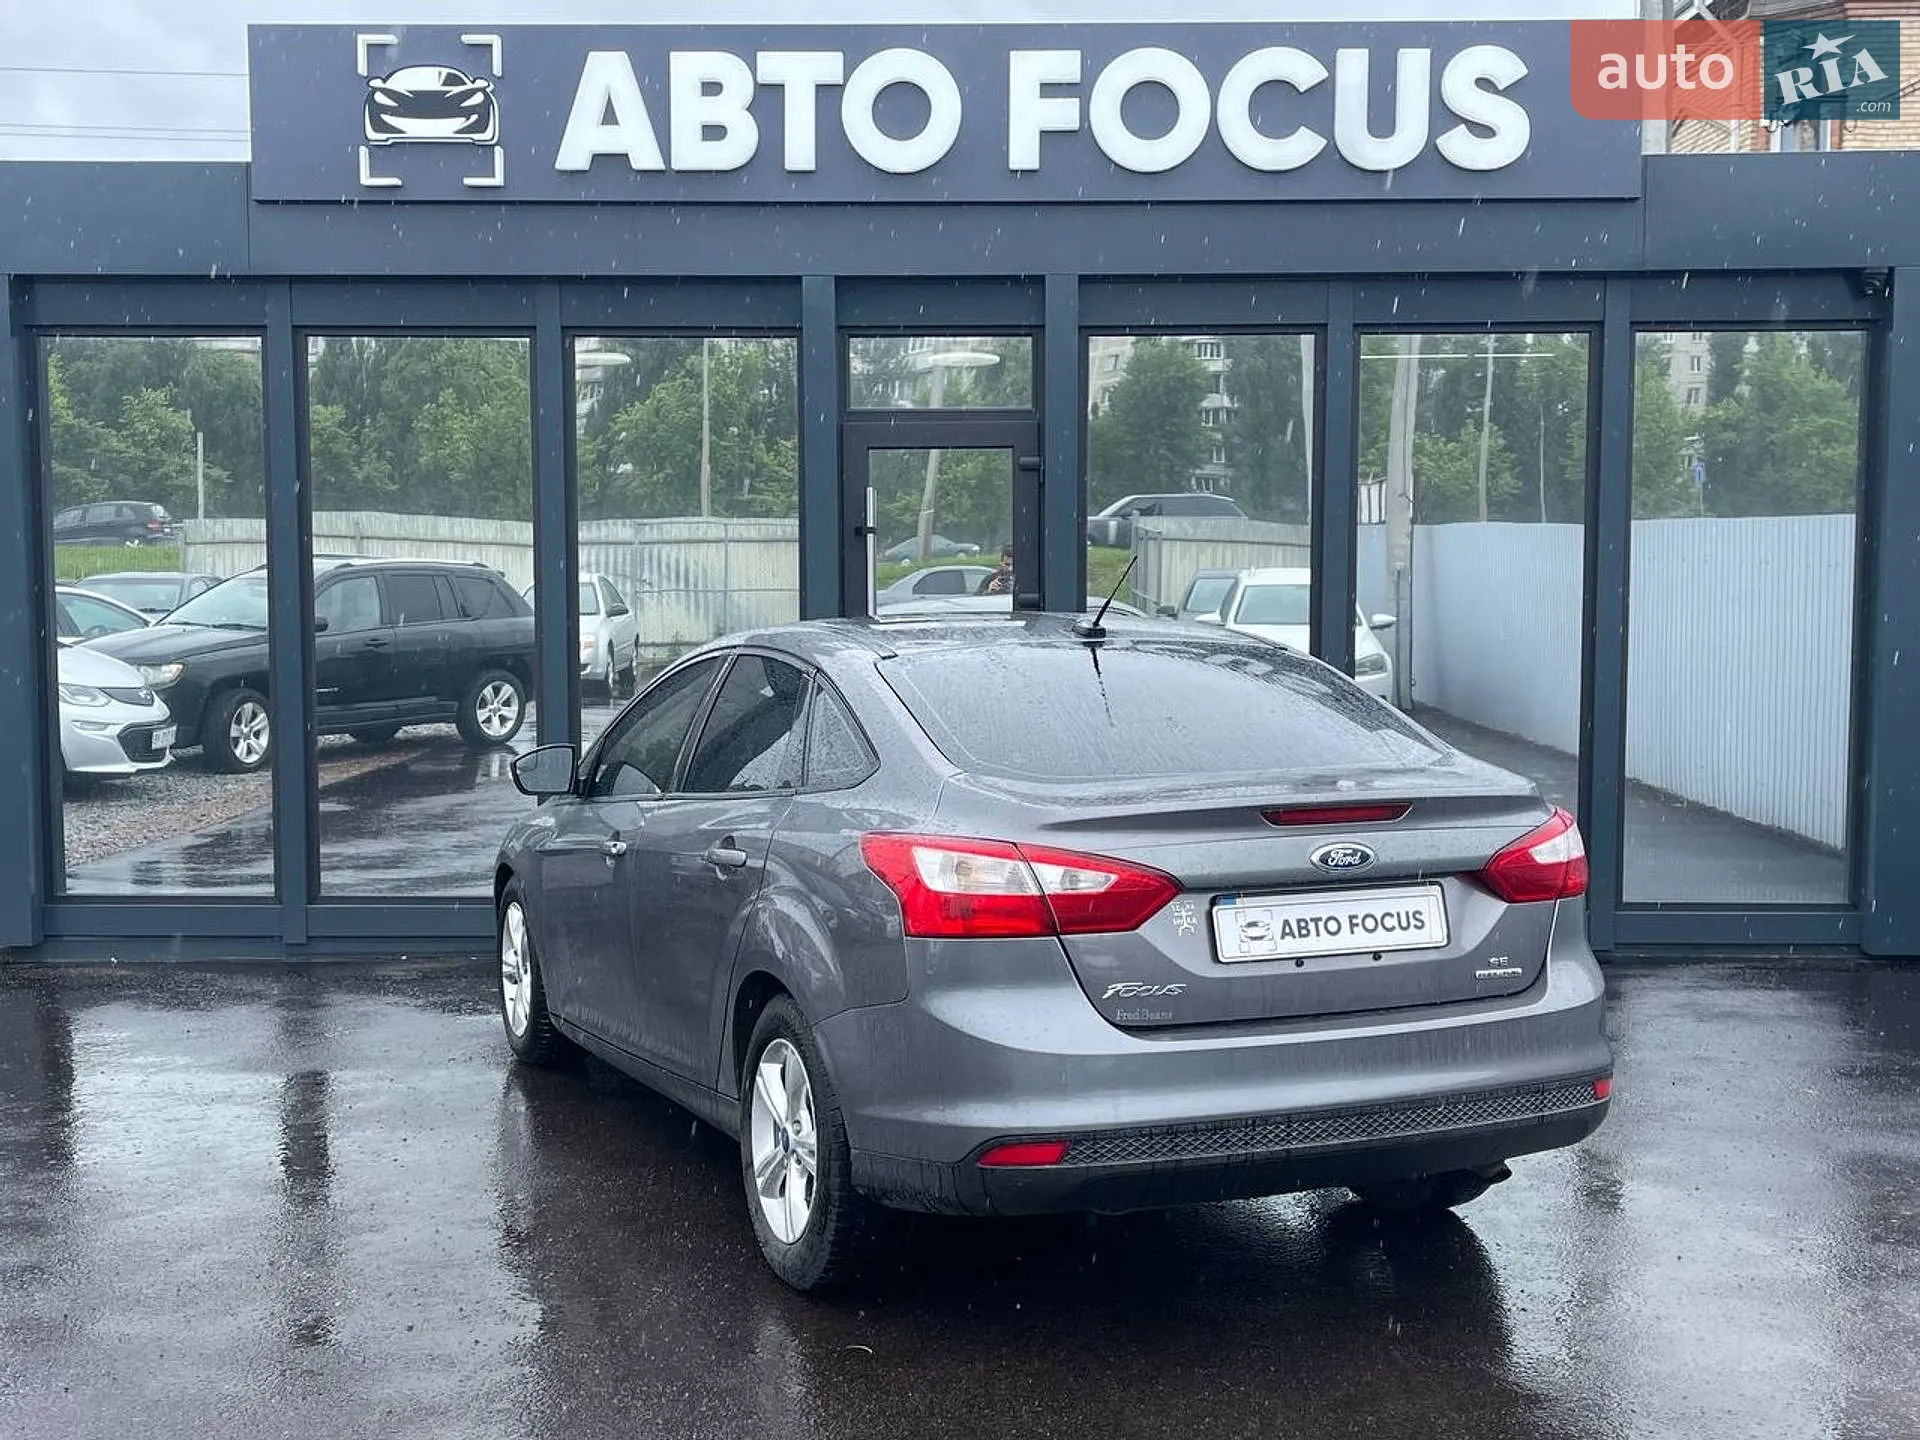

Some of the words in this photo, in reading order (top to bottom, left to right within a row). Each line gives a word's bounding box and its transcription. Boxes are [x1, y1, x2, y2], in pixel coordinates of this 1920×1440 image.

[554, 48, 962, 173] АВТО
[1008, 45, 1531, 172] FOCUS
[1328, 850, 1361, 865] Ford
[1280, 917, 1341, 940] АВТО
[1348, 910, 1425, 934] FOCUS
